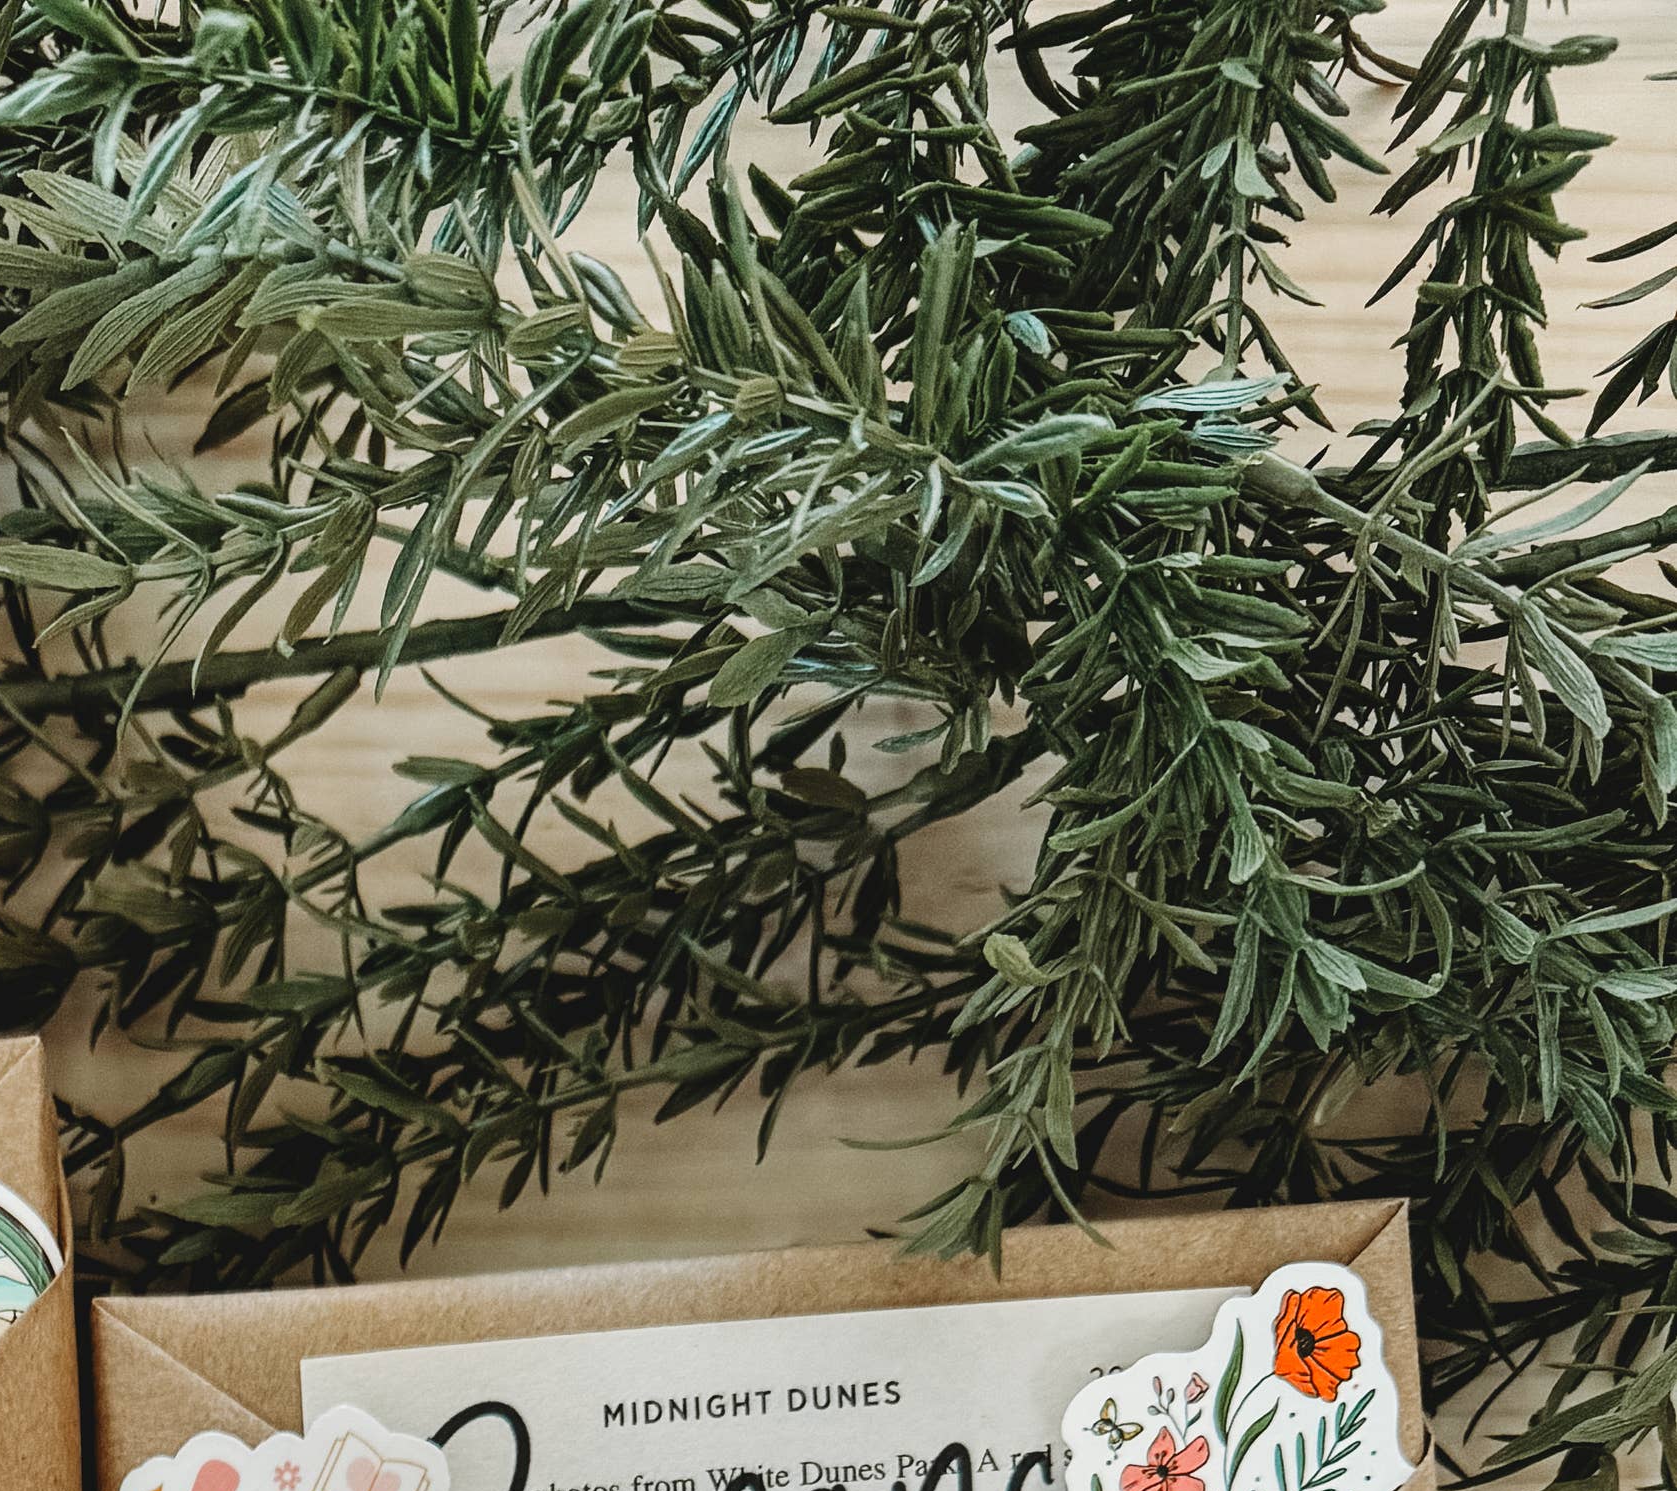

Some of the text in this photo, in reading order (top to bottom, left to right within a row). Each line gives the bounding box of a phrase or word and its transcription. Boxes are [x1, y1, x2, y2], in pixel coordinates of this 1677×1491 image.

[603, 1380, 902, 1429] MIDNIGHT DUNES
[800, 1459, 886, 1486] Dunes
[977, 1448, 1000, 1473] A
